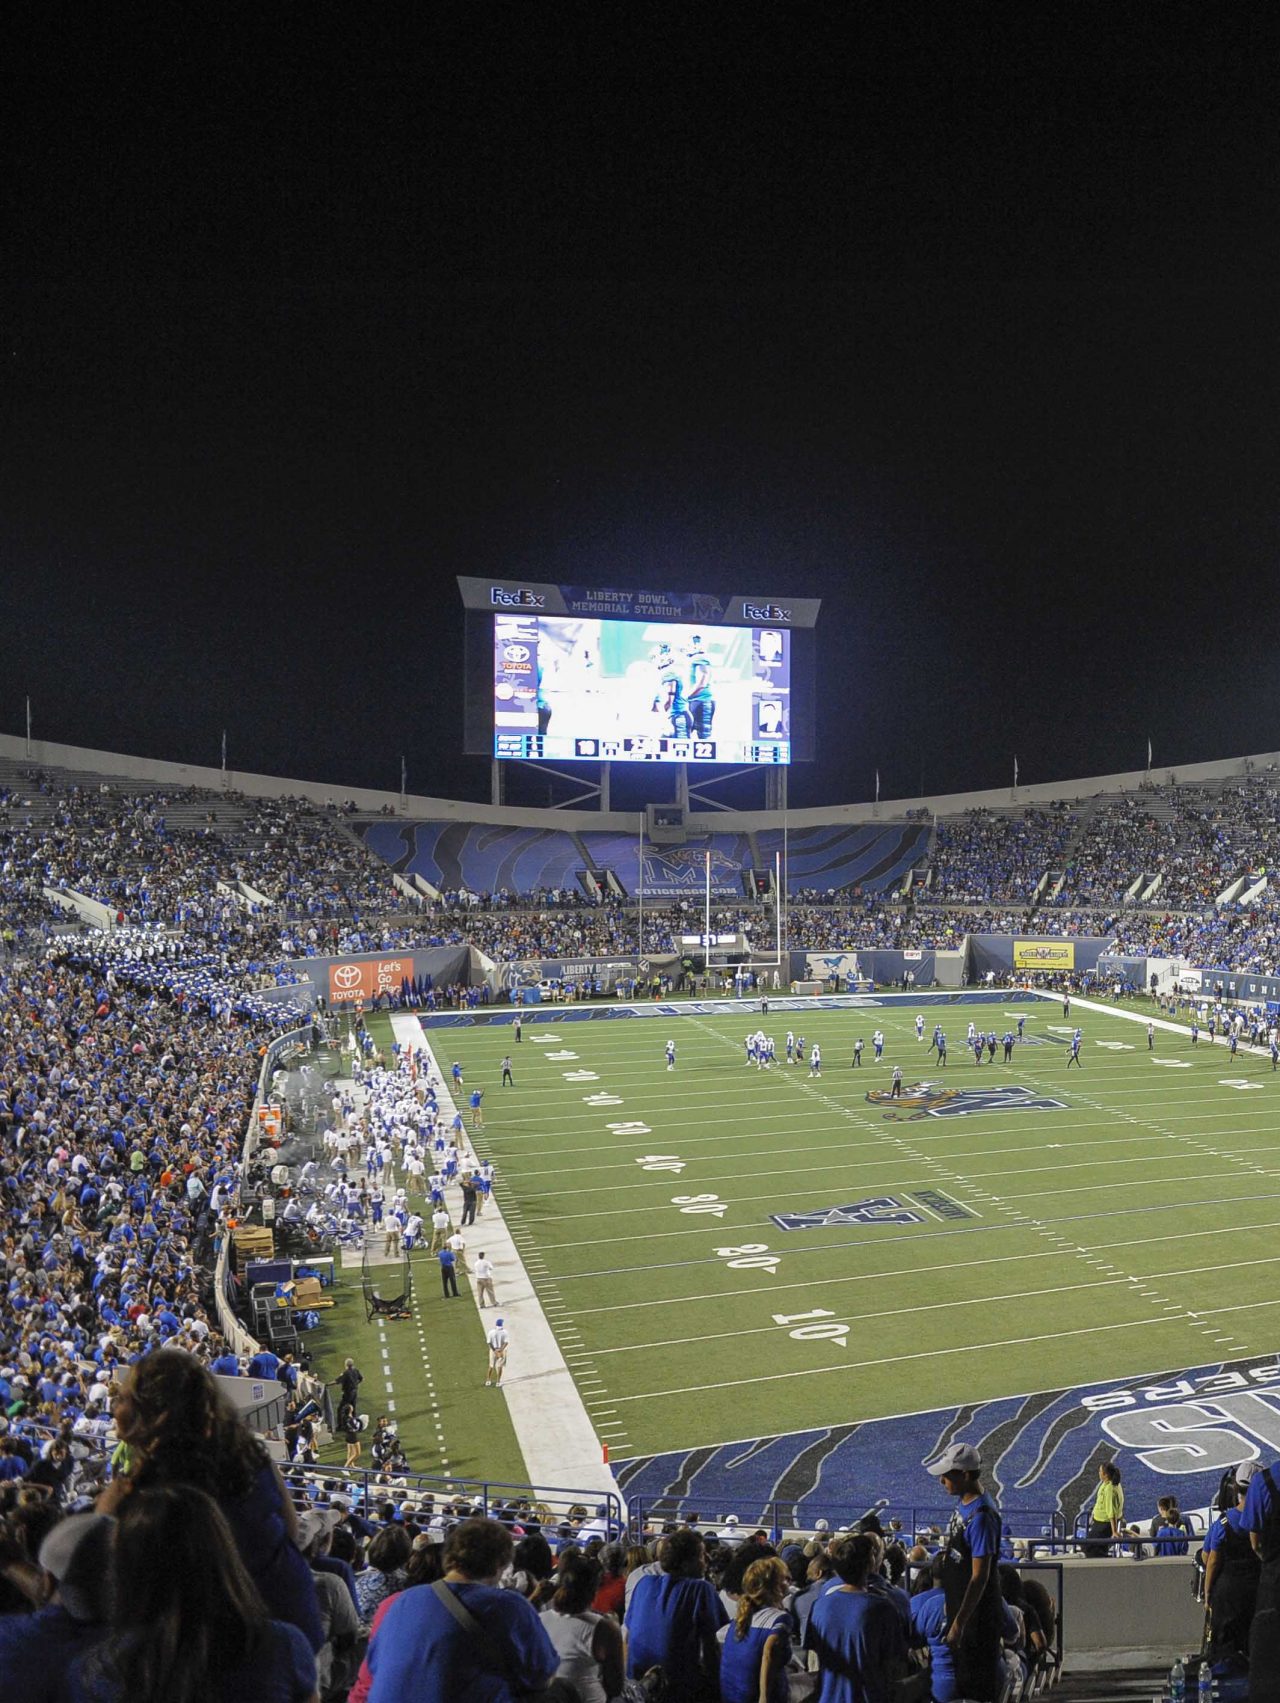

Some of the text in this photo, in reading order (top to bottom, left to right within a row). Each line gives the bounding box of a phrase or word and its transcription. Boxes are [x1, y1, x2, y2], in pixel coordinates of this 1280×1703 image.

[491, 586, 545, 608] FedEx
[586, 590, 669, 605] LIBERTY BOWL
[571, 600, 682, 617] MEMORIAL STADIUM
[743, 602, 792, 622] FedEx
[502, 662, 533, 671] TOYOTA
[563, 963, 595, 976] LIBERTY
[378, 973, 393, 984] Go
[1204, 978, 1236, 991] THE
[331, 989, 366, 1000] TOYOTA
[604, 1121, 653, 1135] 50
[635, 1154, 687, 1171] 40
[670, 1193, 729, 1215] 30
[712, 1243, 782, 1269] 20
[771, 1308, 851, 1341] 10
